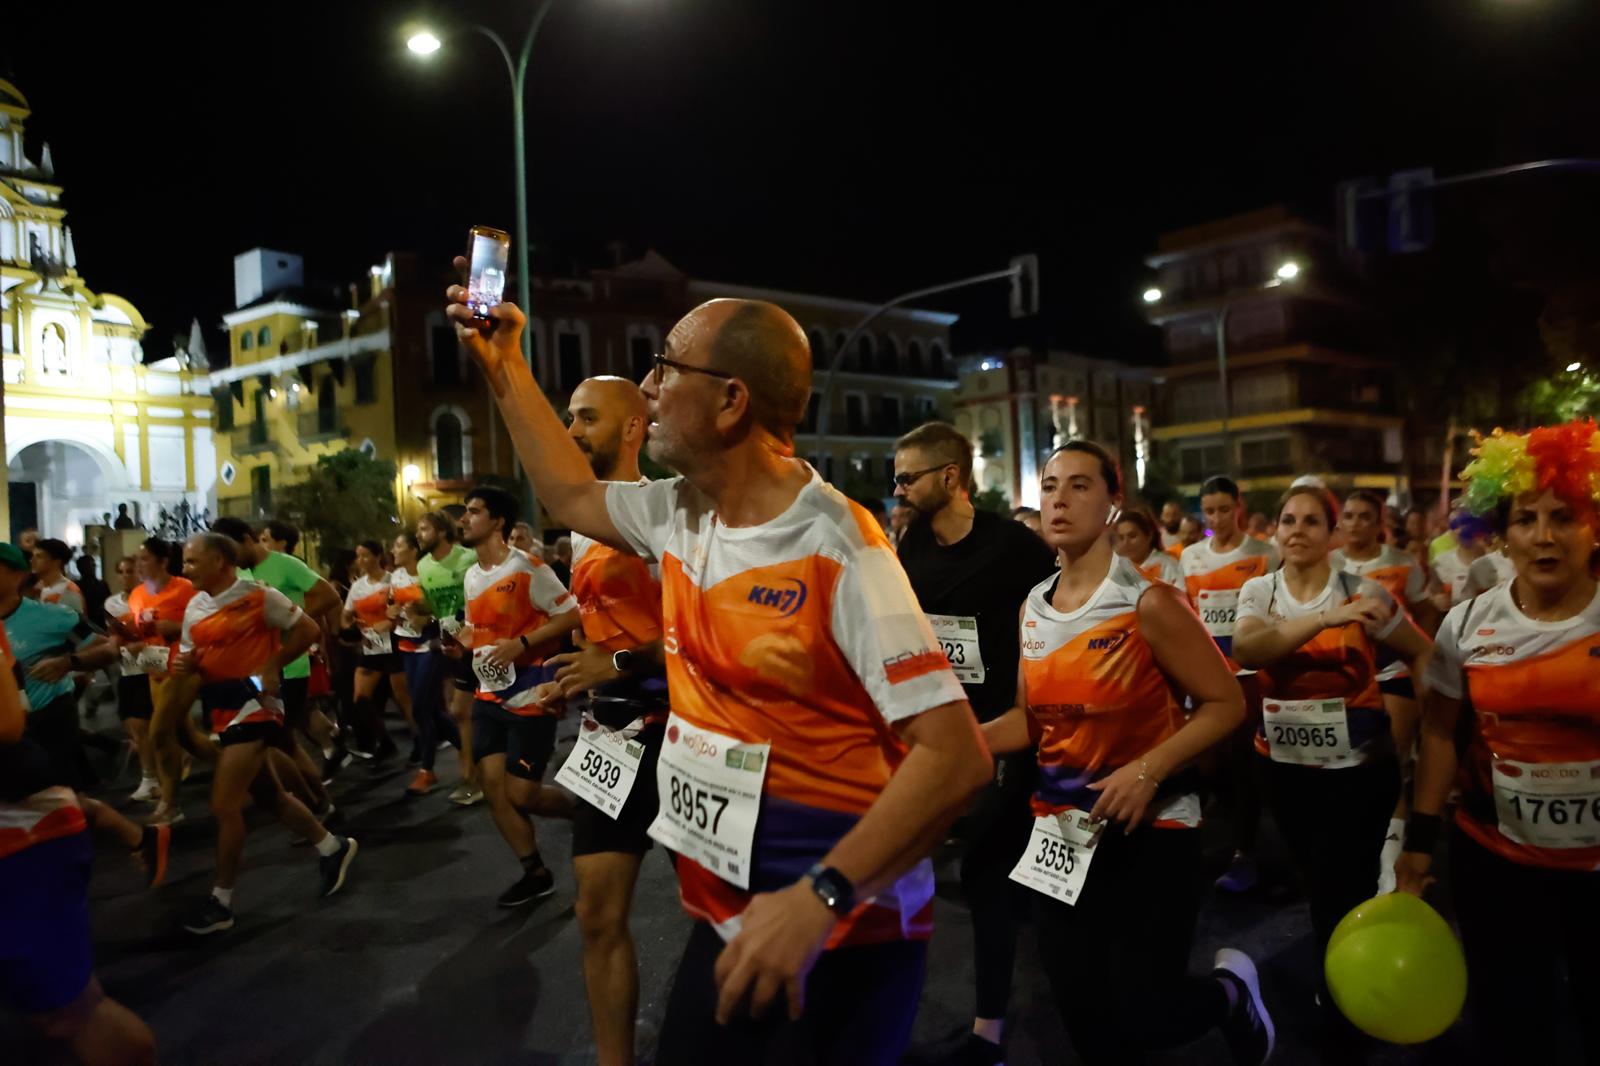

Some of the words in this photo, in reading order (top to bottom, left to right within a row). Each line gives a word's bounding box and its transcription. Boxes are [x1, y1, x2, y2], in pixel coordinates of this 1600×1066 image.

[938, 641, 965, 664] 23
[1273, 726, 1337, 747] 20965
[580, 748, 621, 789] 5939
[670, 775, 729, 835] 8957
[1035, 838, 1075, 874] 3555
